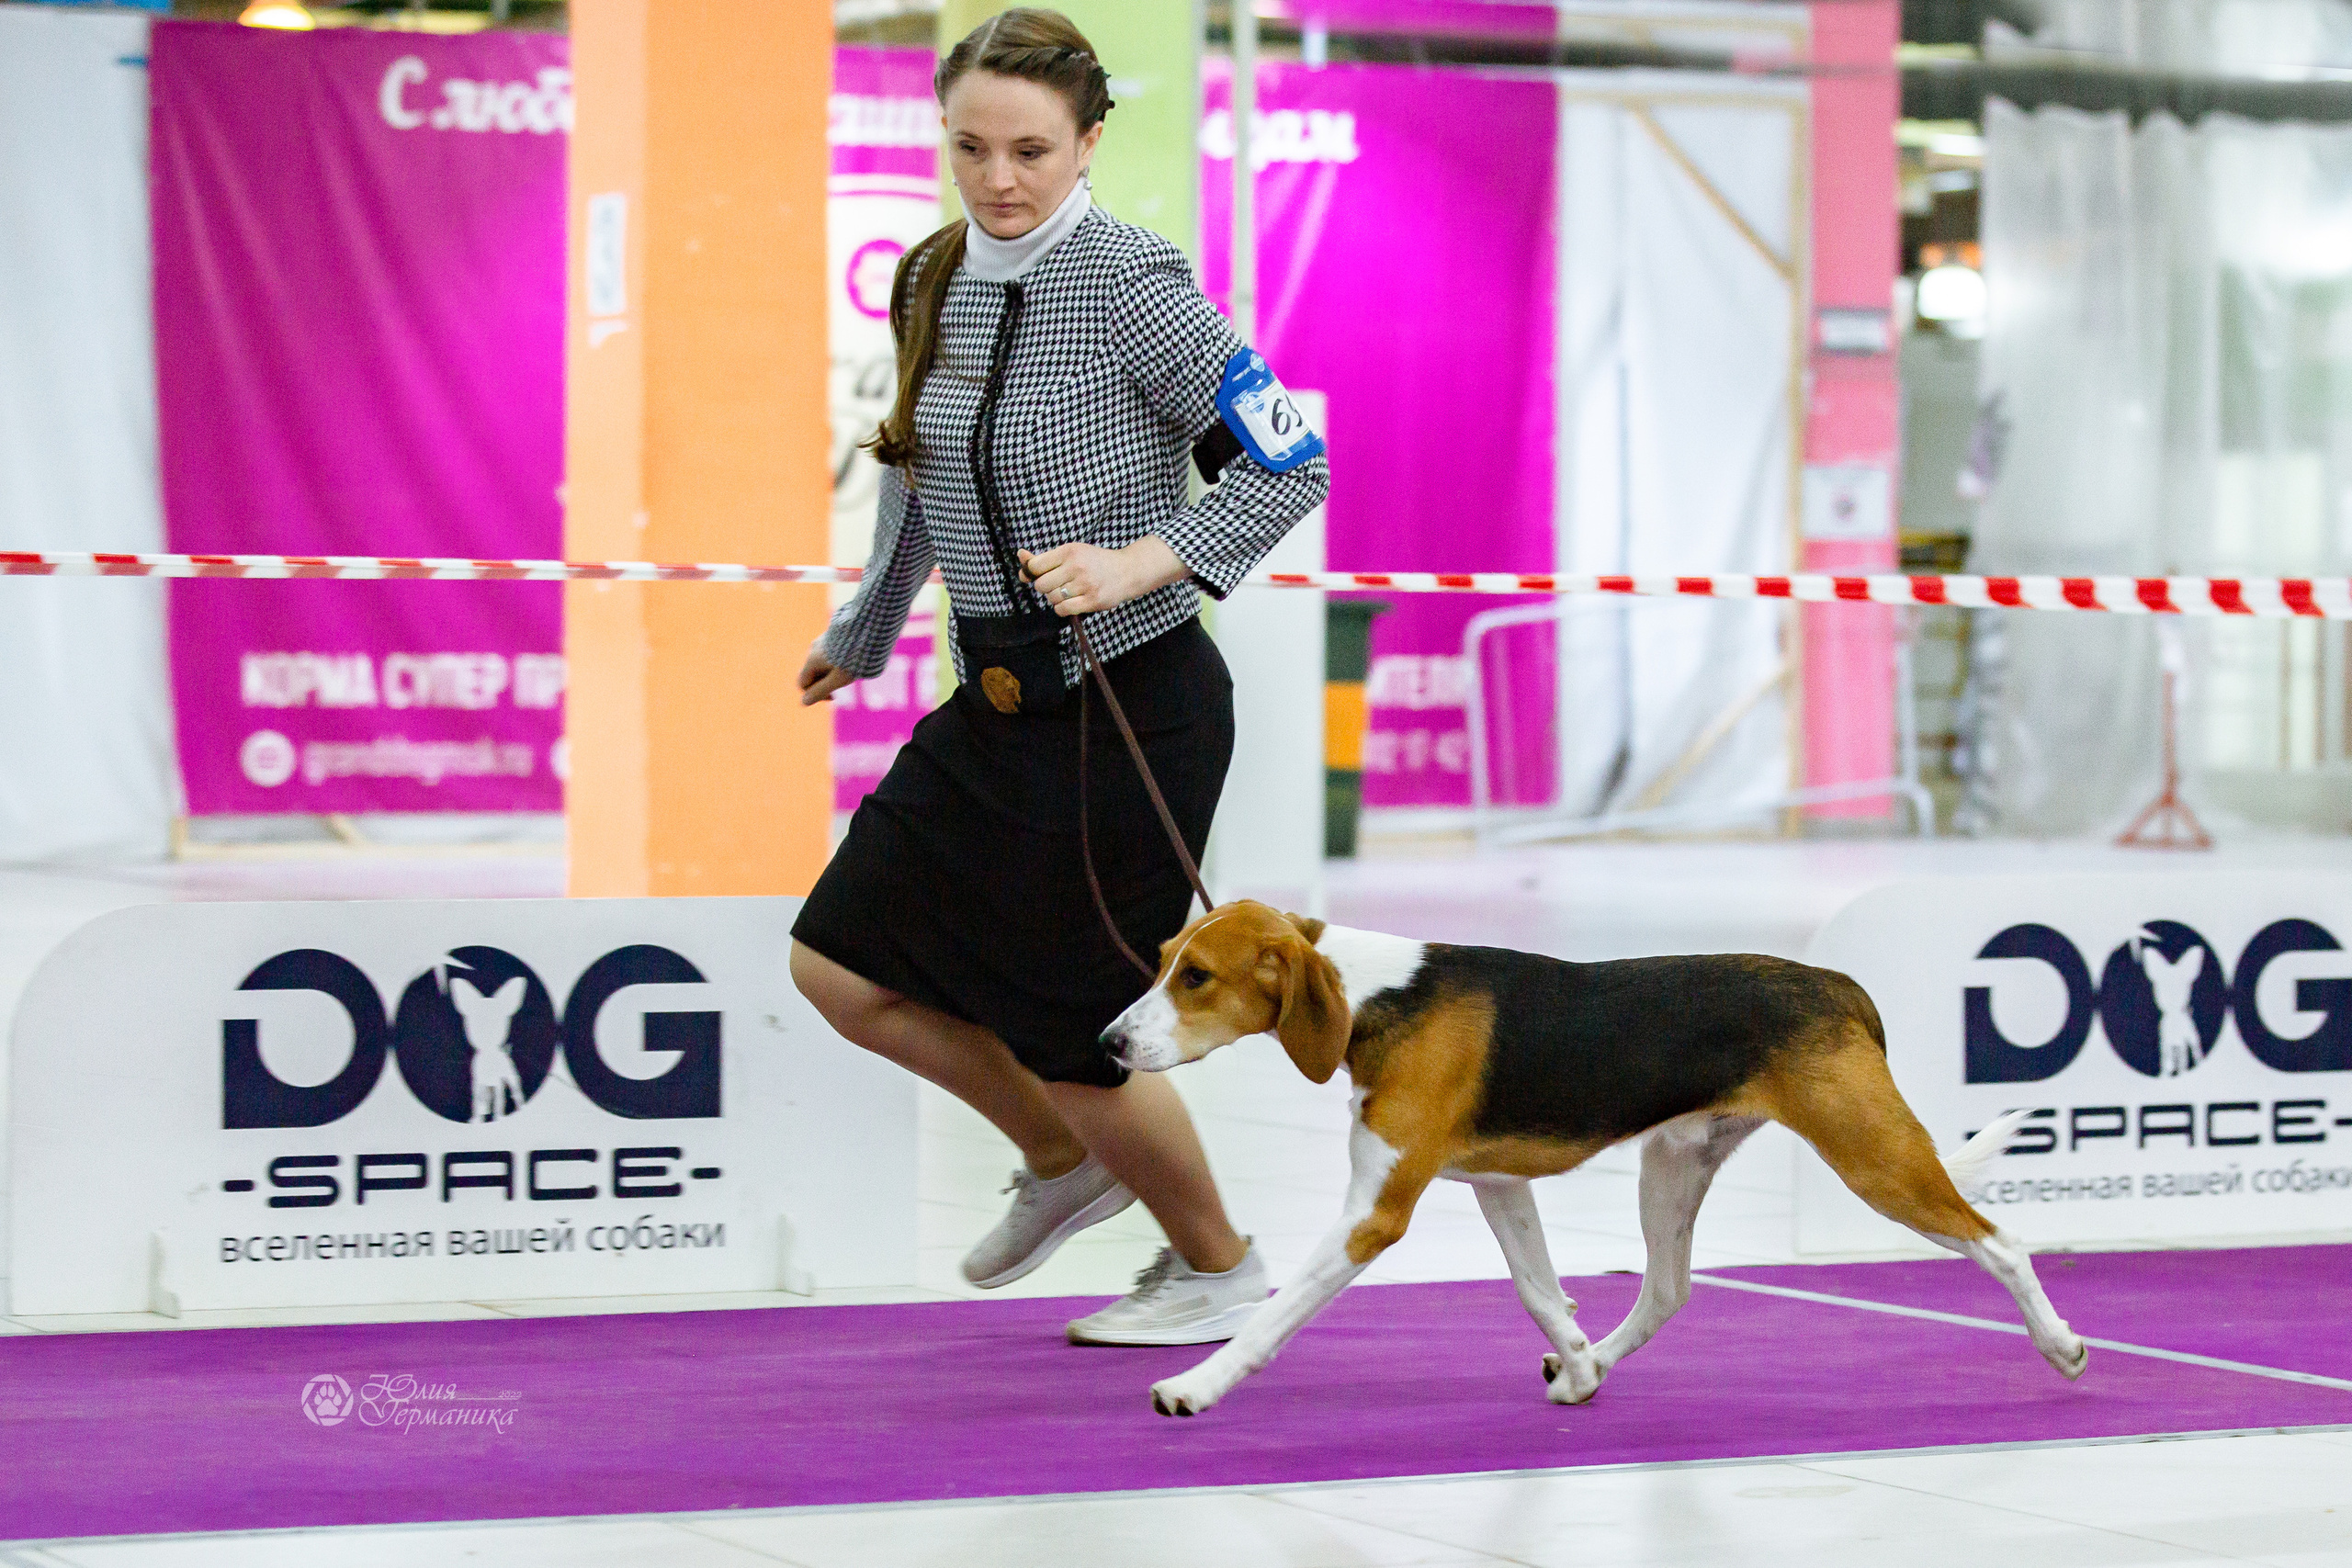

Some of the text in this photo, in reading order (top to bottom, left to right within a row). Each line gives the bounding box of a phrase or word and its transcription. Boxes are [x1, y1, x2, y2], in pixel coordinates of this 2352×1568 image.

[379, 55, 428, 130] С
[240, 651, 378, 709] КОРМА
[383, 651, 508, 710] СУПЕР
[1963, 919, 2352, 1084] DOG
[220, 944, 723, 1130] DOG
[2142, 1163, 2244, 1198] вашей
[220, 1215, 728, 1263] вселенная вашей собаки
